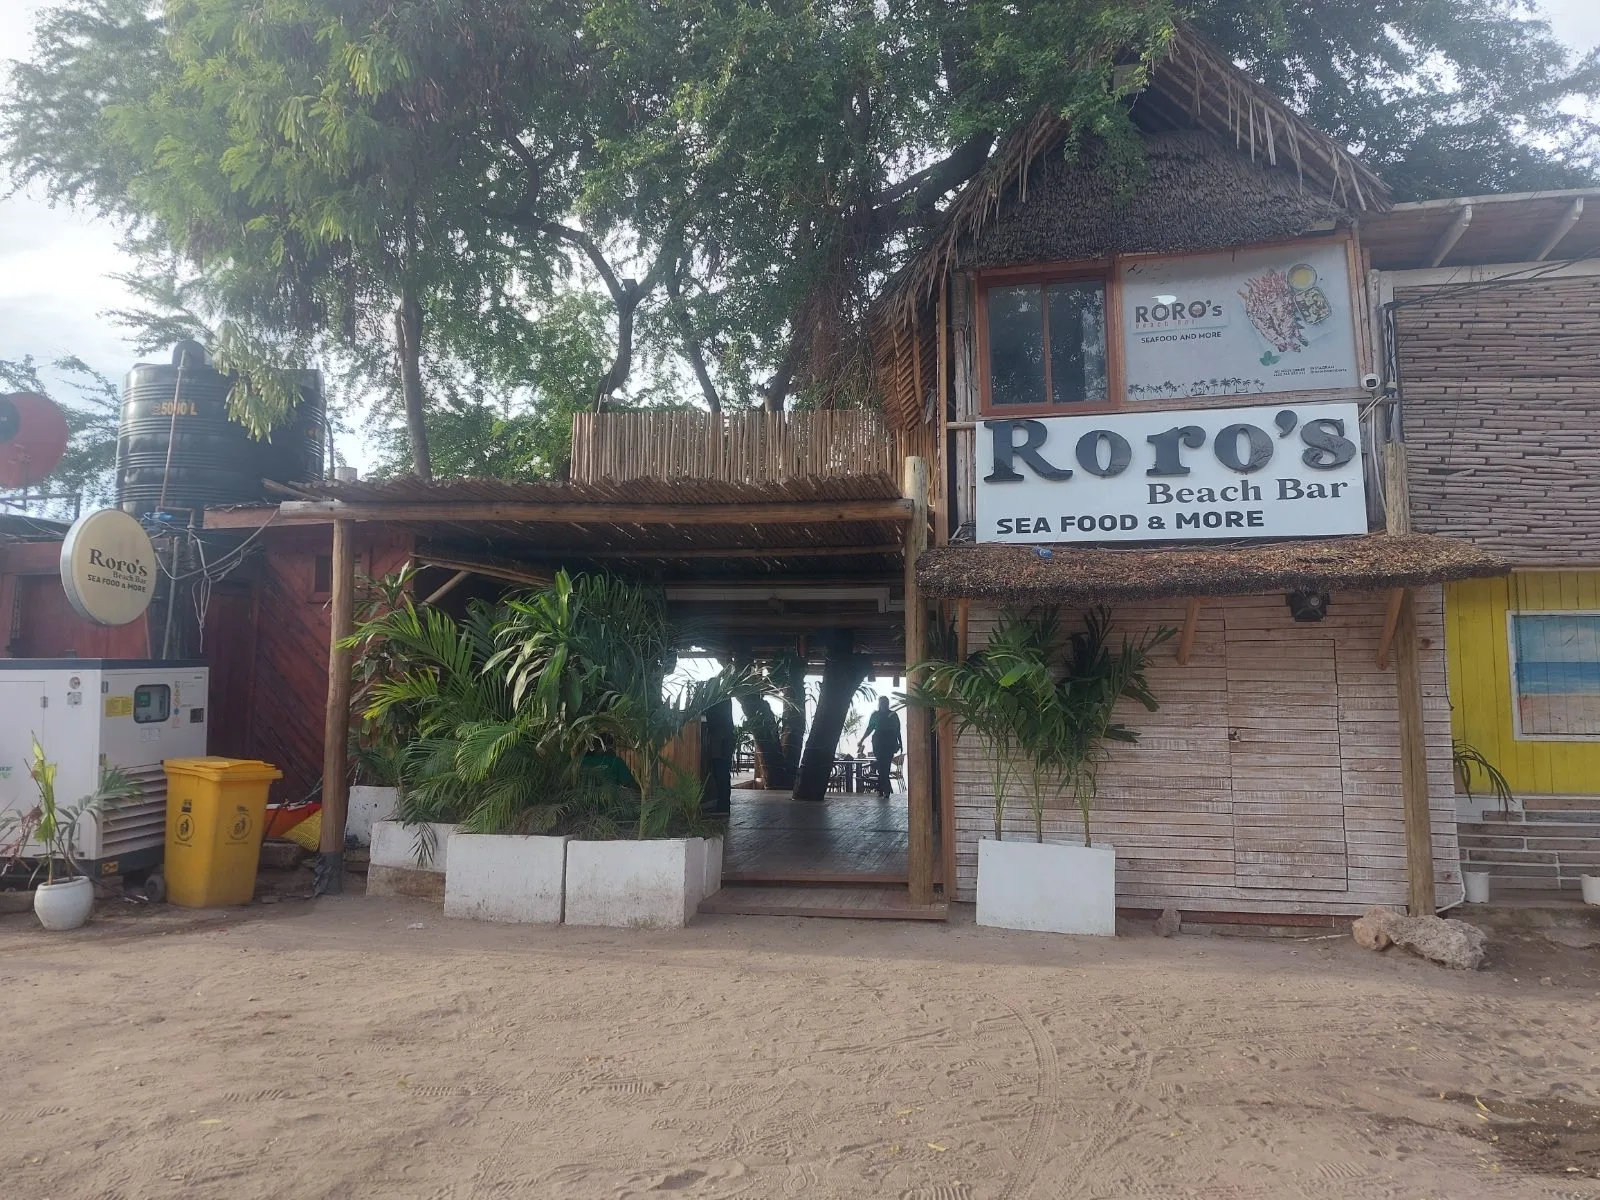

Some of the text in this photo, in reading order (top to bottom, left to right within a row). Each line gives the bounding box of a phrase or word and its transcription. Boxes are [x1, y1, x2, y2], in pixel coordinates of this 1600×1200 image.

[1135, 300, 1223, 323] RORO's
[1141, 331, 1222, 344] SEAFOOD AND MORE
[983, 409, 1356, 483] Roro's
[1146, 478, 1348, 505] Beach Bar
[996, 510, 1265, 535] SEA FOOD & MORE
[89, 548, 148, 577] Roro's
[88, 574, 101, 583] SEA
[102, 578, 120, 588] FOOD
[127, 583, 146, 593] MORE
